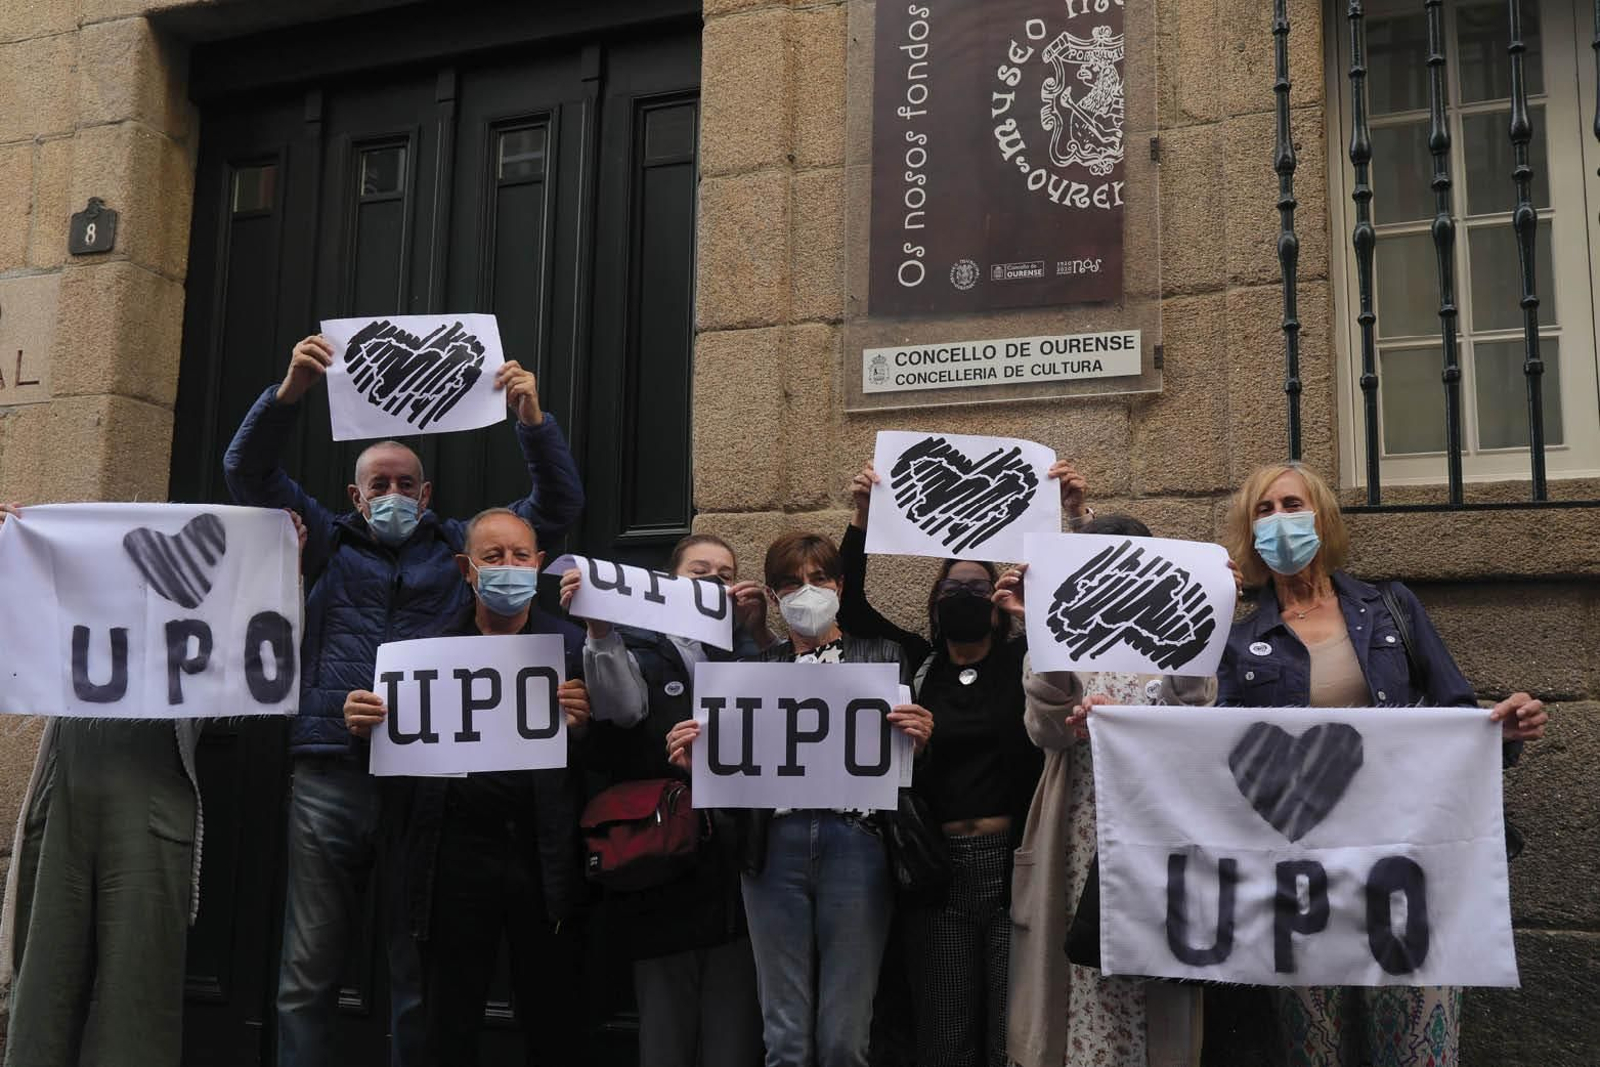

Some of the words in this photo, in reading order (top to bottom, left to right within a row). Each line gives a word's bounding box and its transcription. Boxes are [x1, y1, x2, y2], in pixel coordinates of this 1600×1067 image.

[897, 4, 930, 120] fondos
[904, 130, 928, 229] nosos
[85, 223, 97, 245] 8
[897, 242, 926, 287] Os
[1006, 269, 1042, 278] OURENSE
[895, 345, 997, 366] CONCELLO
[1005, 342, 1031, 358] DE
[1039, 335, 1135, 356] OURENSE
[895, 367, 998, 386] CONCELLERIA
[1004, 365, 1025, 378] DE
[1030, 359, 1103, 376] CULTURA
[72, 610, 295, 705] UPO
[1166, 853, 1430, 976] UPO
